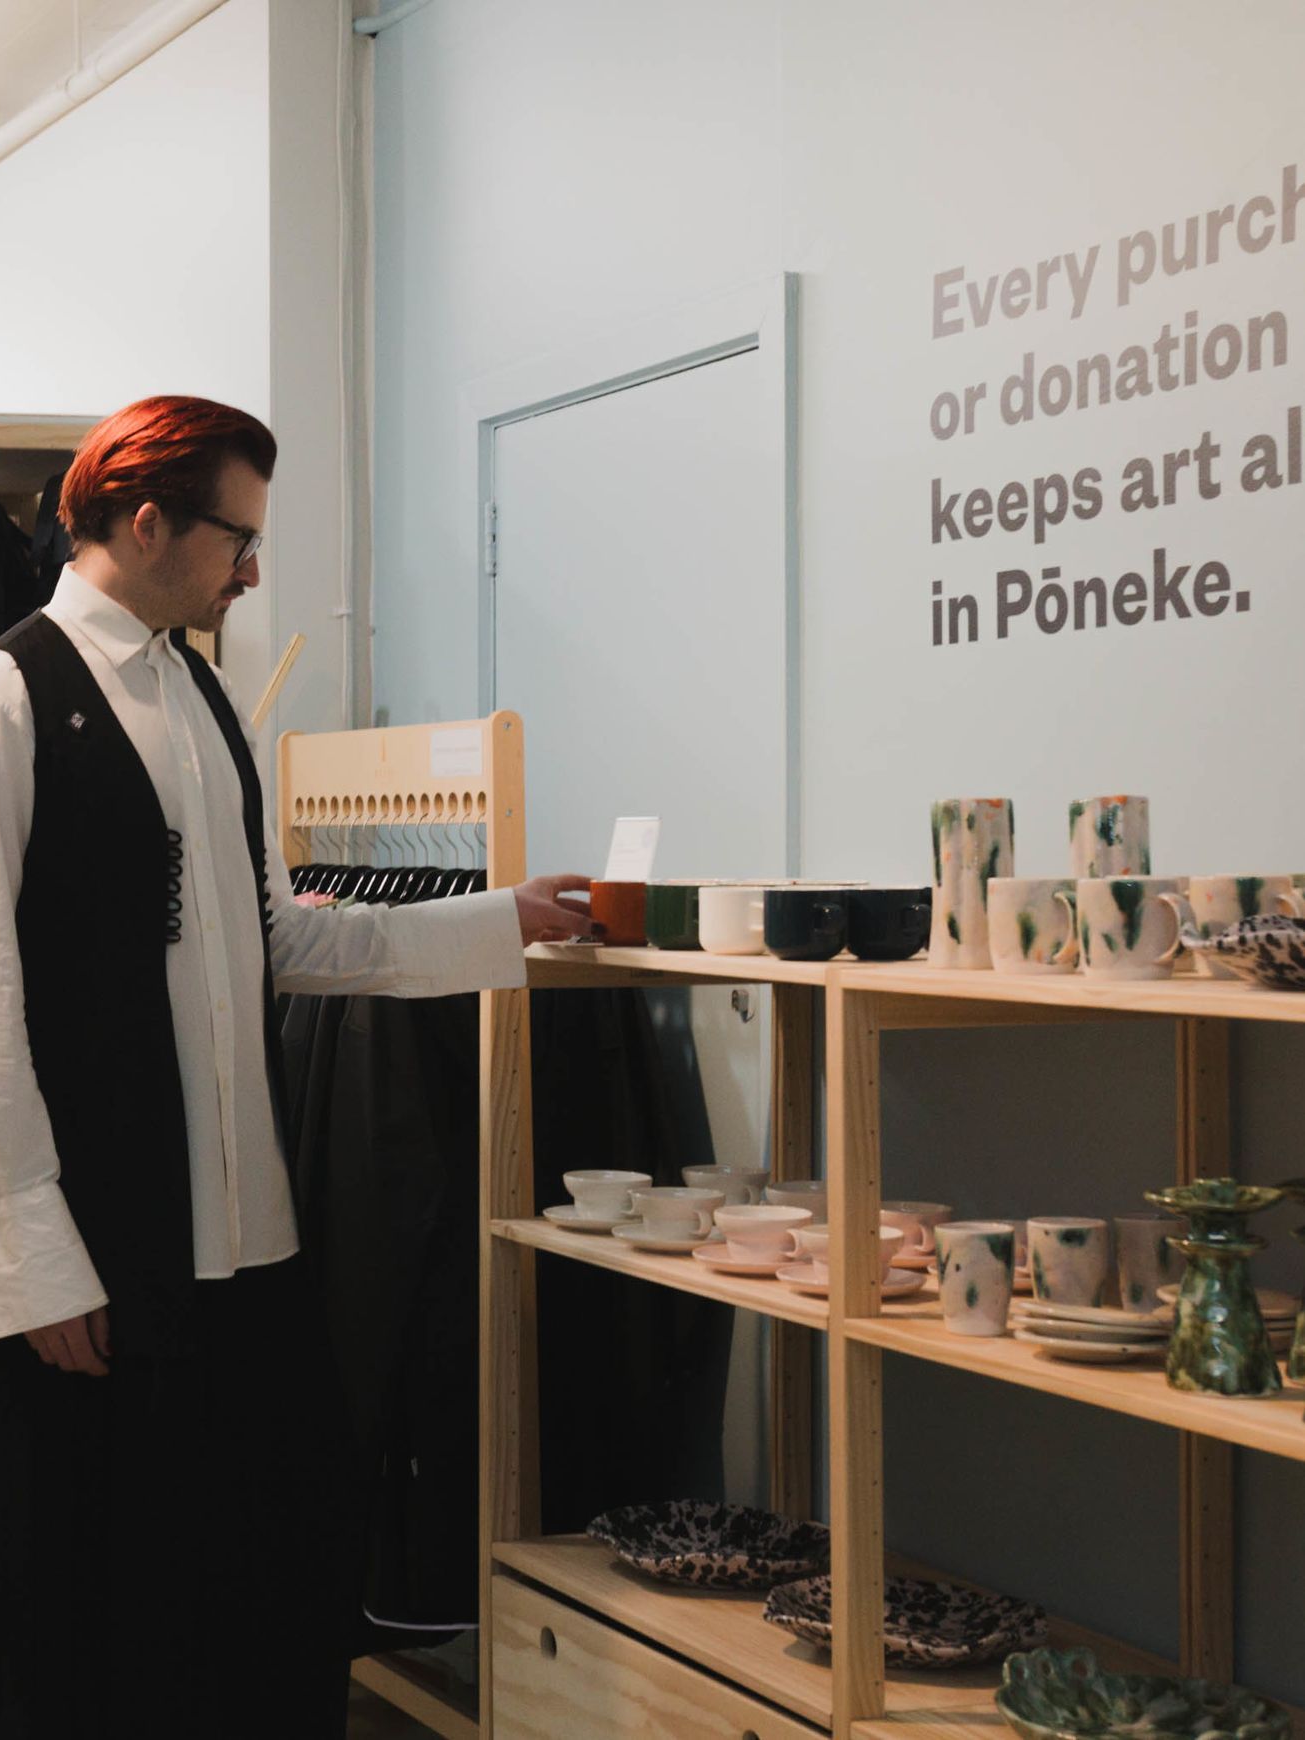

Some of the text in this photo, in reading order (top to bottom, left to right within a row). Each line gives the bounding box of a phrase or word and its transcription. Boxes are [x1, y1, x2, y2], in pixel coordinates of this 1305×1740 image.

[931, 245, 1101, 340] Every
[929, 310, 1288, 441] or donation
[931, 466, 1103, 545] keeps
[1119, 431, 1221, 513] art
[932, 547, 1252, 646] in Pōneke.
